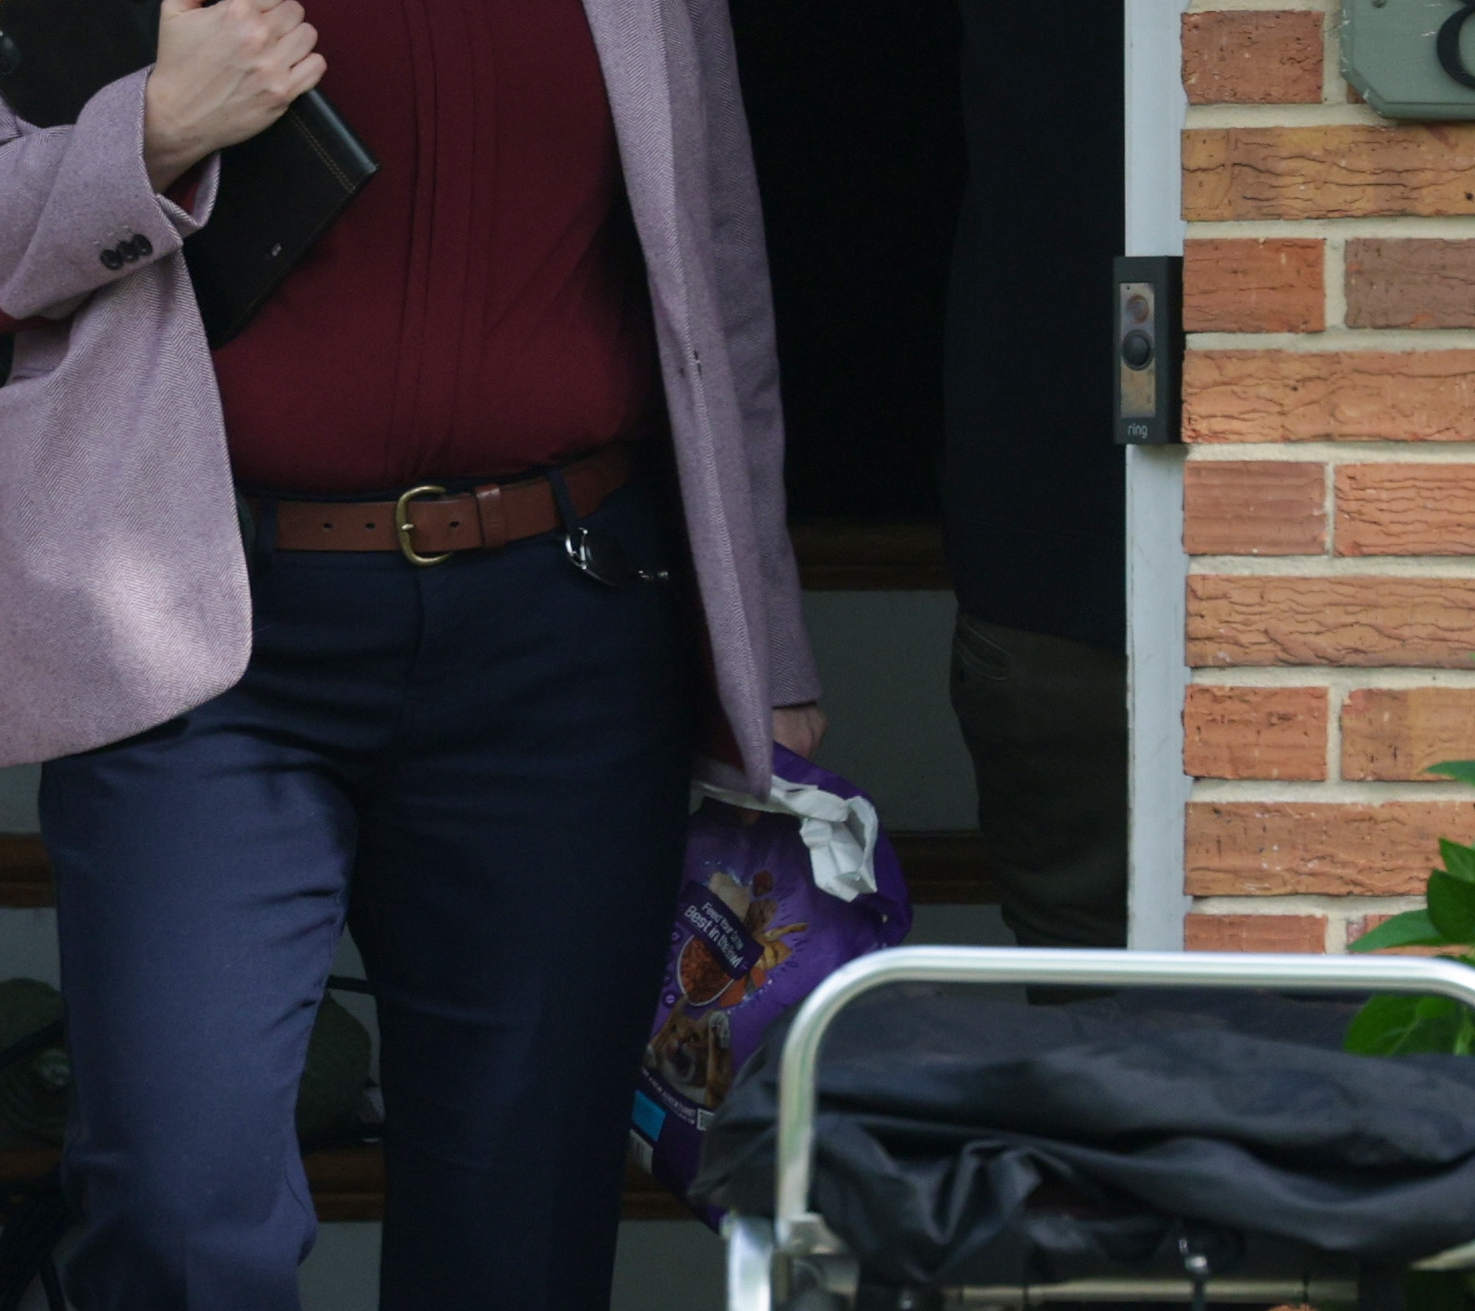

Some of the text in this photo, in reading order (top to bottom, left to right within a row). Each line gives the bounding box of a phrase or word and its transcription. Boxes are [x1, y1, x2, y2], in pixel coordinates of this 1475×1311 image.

[1127, 423, 1148, 439] ring
[702, 902, 723, 923] Feed
[684, 905, 713, 932] Best
[708, 925, 721, 942] in
